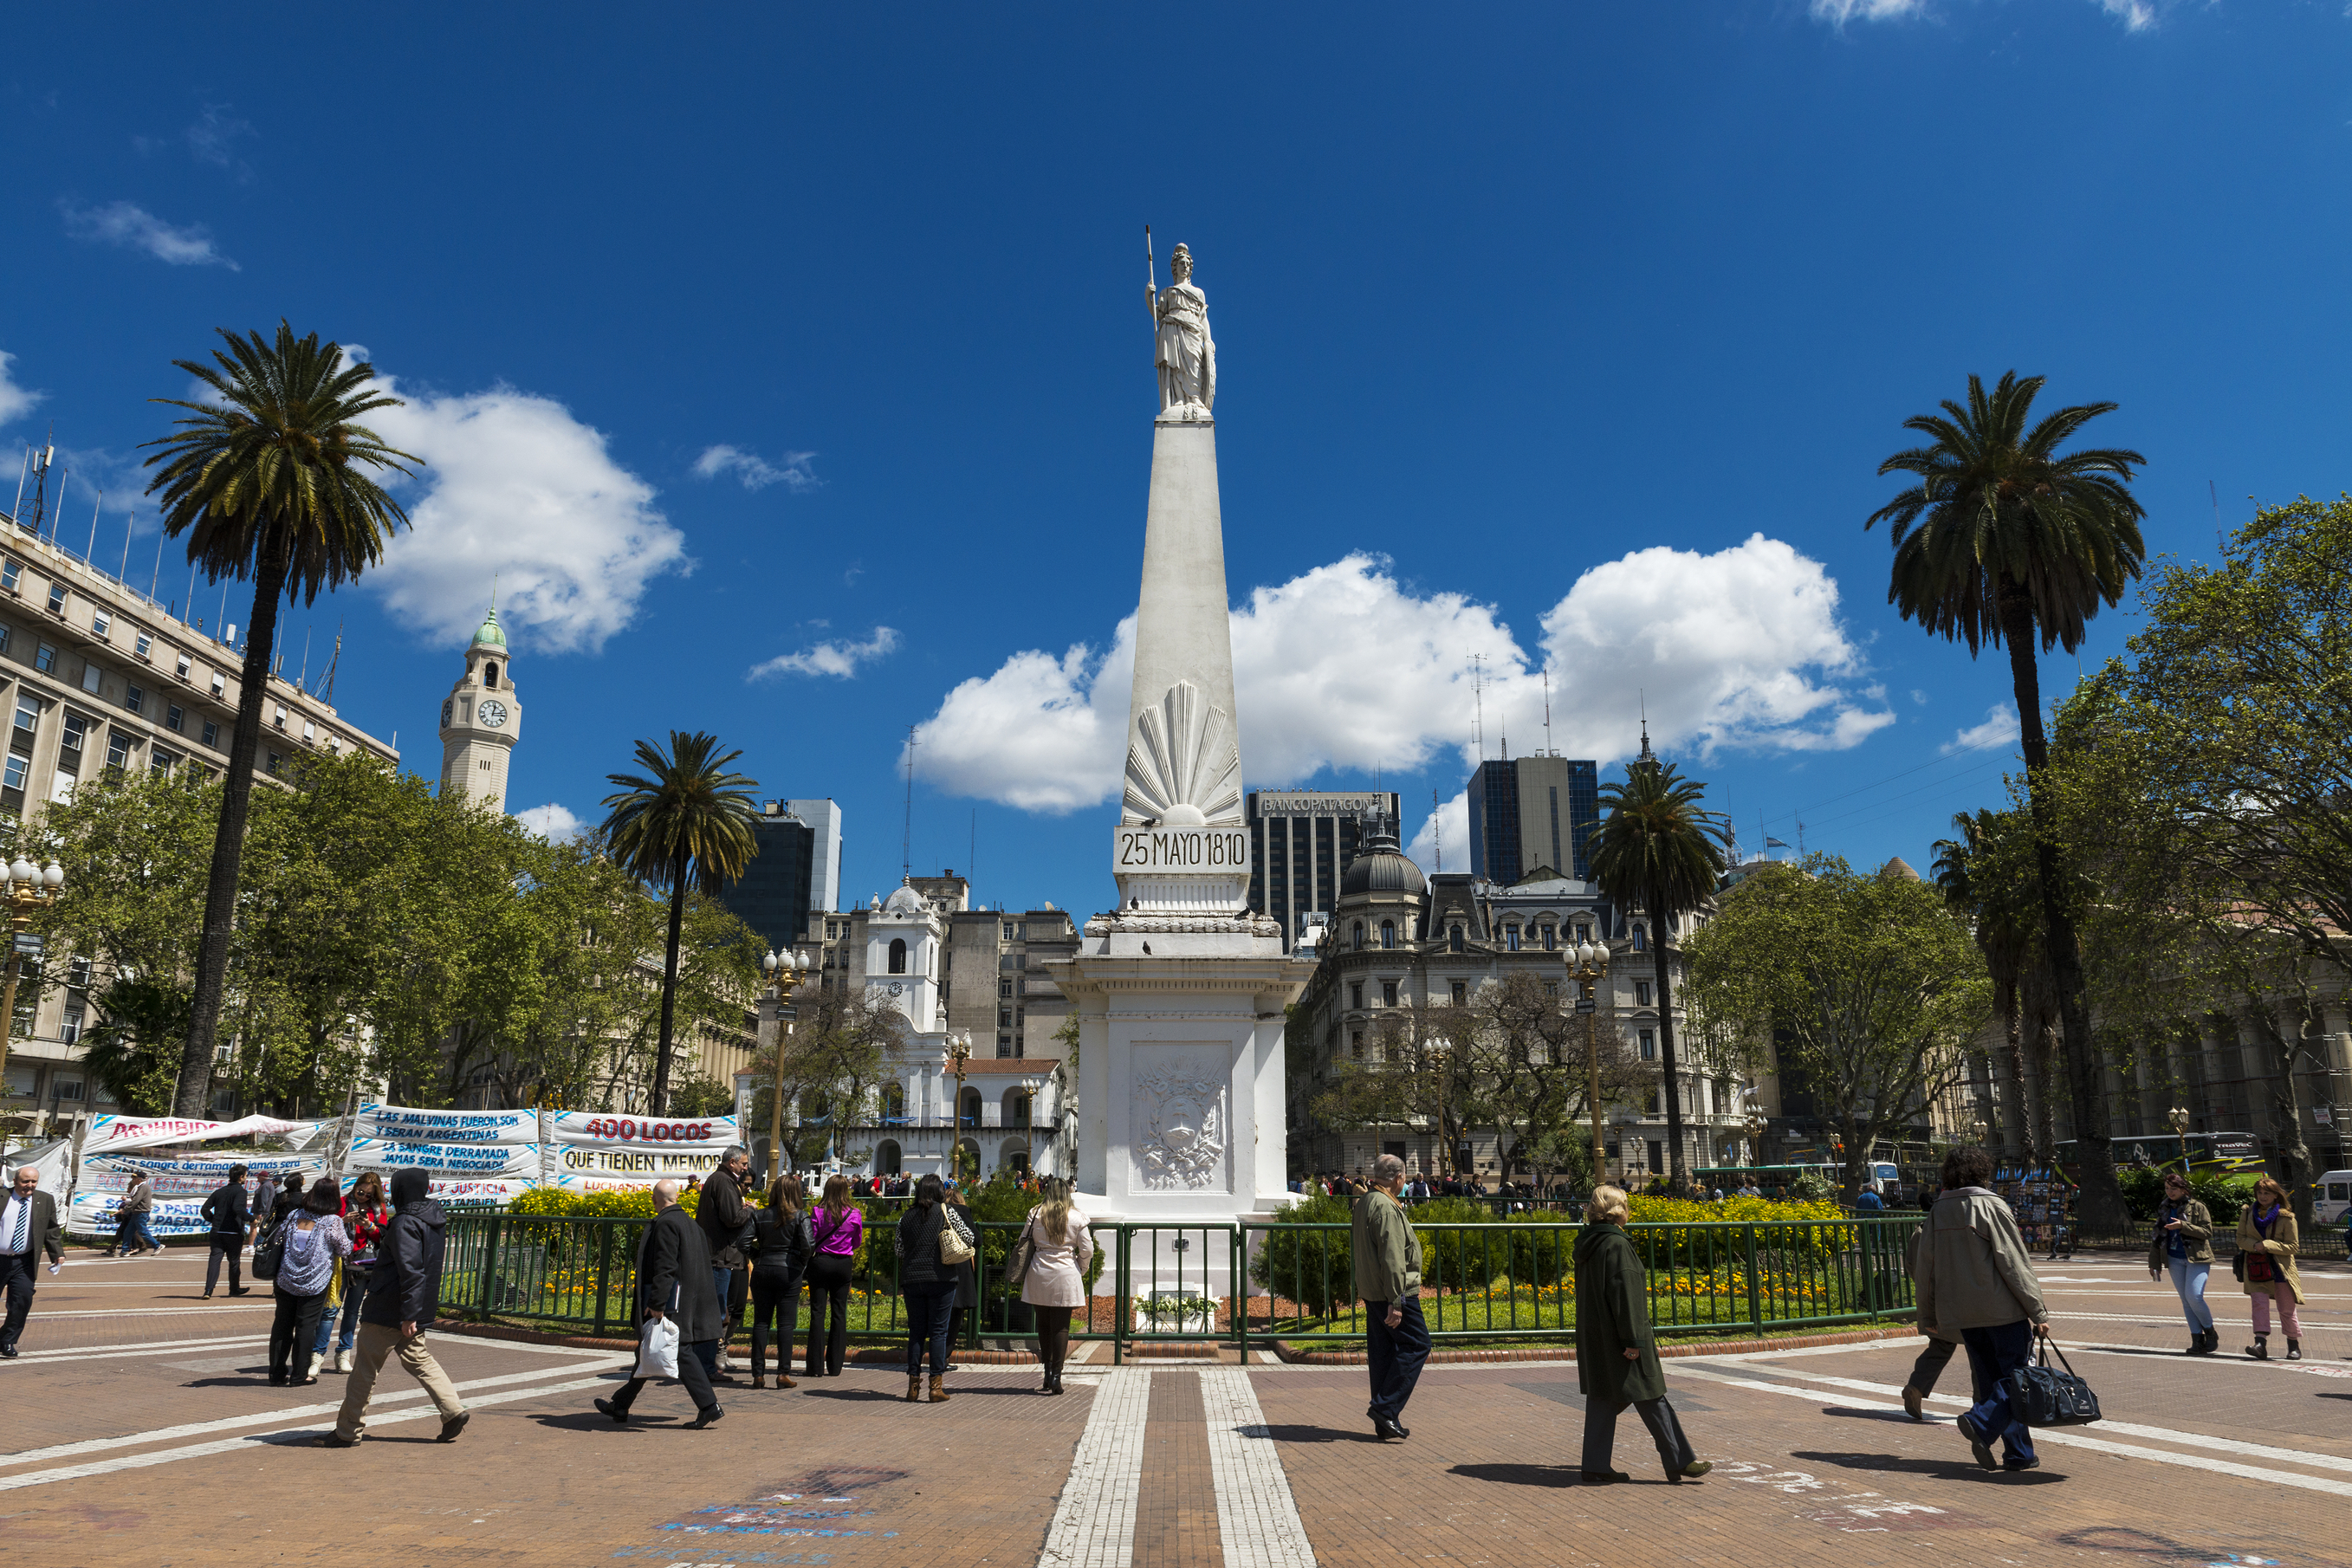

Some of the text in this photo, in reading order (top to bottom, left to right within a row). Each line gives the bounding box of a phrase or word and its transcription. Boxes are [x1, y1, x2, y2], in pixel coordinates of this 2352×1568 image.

[1121, 833, 1244, 865] 25 MAYO 1810
[375, 1111, 399, 1123] LAS
[401, 1114, 458, 1127] MALVINAS
[499, 1116, 519, 1126] SON
[375, 1125, 499, 1141] Y SERAN ARGENTINAS
[584, 1118, 713, 1144] 400 LOCOS
[398, 1142, 443, 1156] SANGRE
[444, 1146, 509, 1160] DERRAMADA
[139, 1161, 178, 1171] sangre
[182, 1161, 243, 1170] derramad
[280, 1157, 301, 1168] será
[381, 1154, 504, 1170] JAMAS SERA NEGOCIADA
[565, 1150, 722, 1172] QUE TIENEN MEMOR
[450, 1182, 508, 1195] JUSTICIA
[164, 1204, 203, 1216] PART
